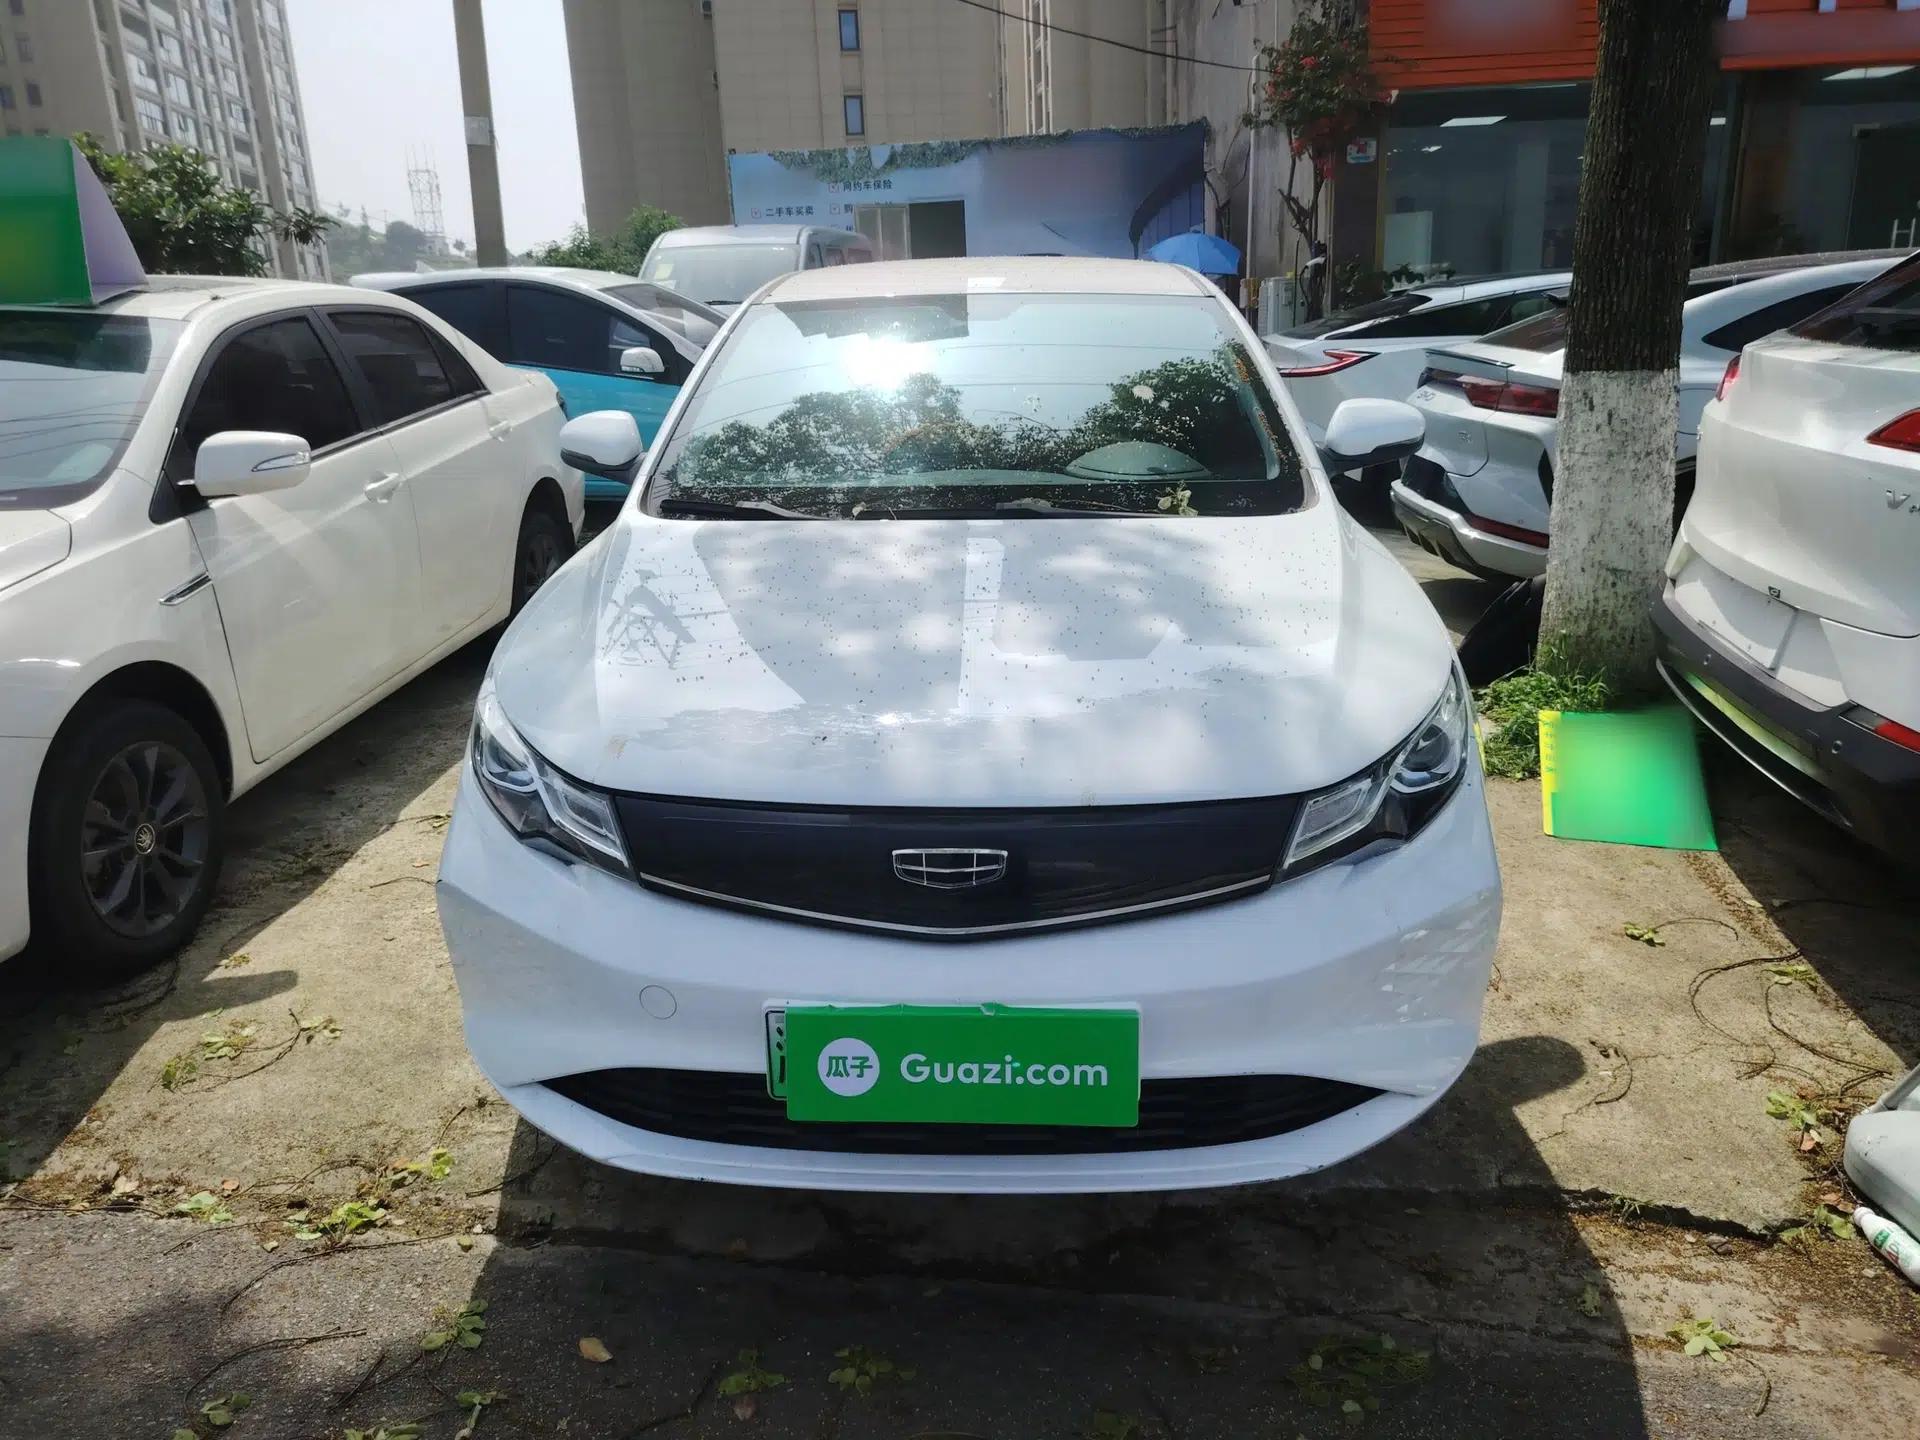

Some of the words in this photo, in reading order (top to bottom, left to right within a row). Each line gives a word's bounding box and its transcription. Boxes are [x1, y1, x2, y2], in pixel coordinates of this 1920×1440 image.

[765, 205, 814, 217] 二手车买卖
[826, 1055, 874, 1079] 瓜子
[900, 1052, 1109, 1087] Guazi.com
